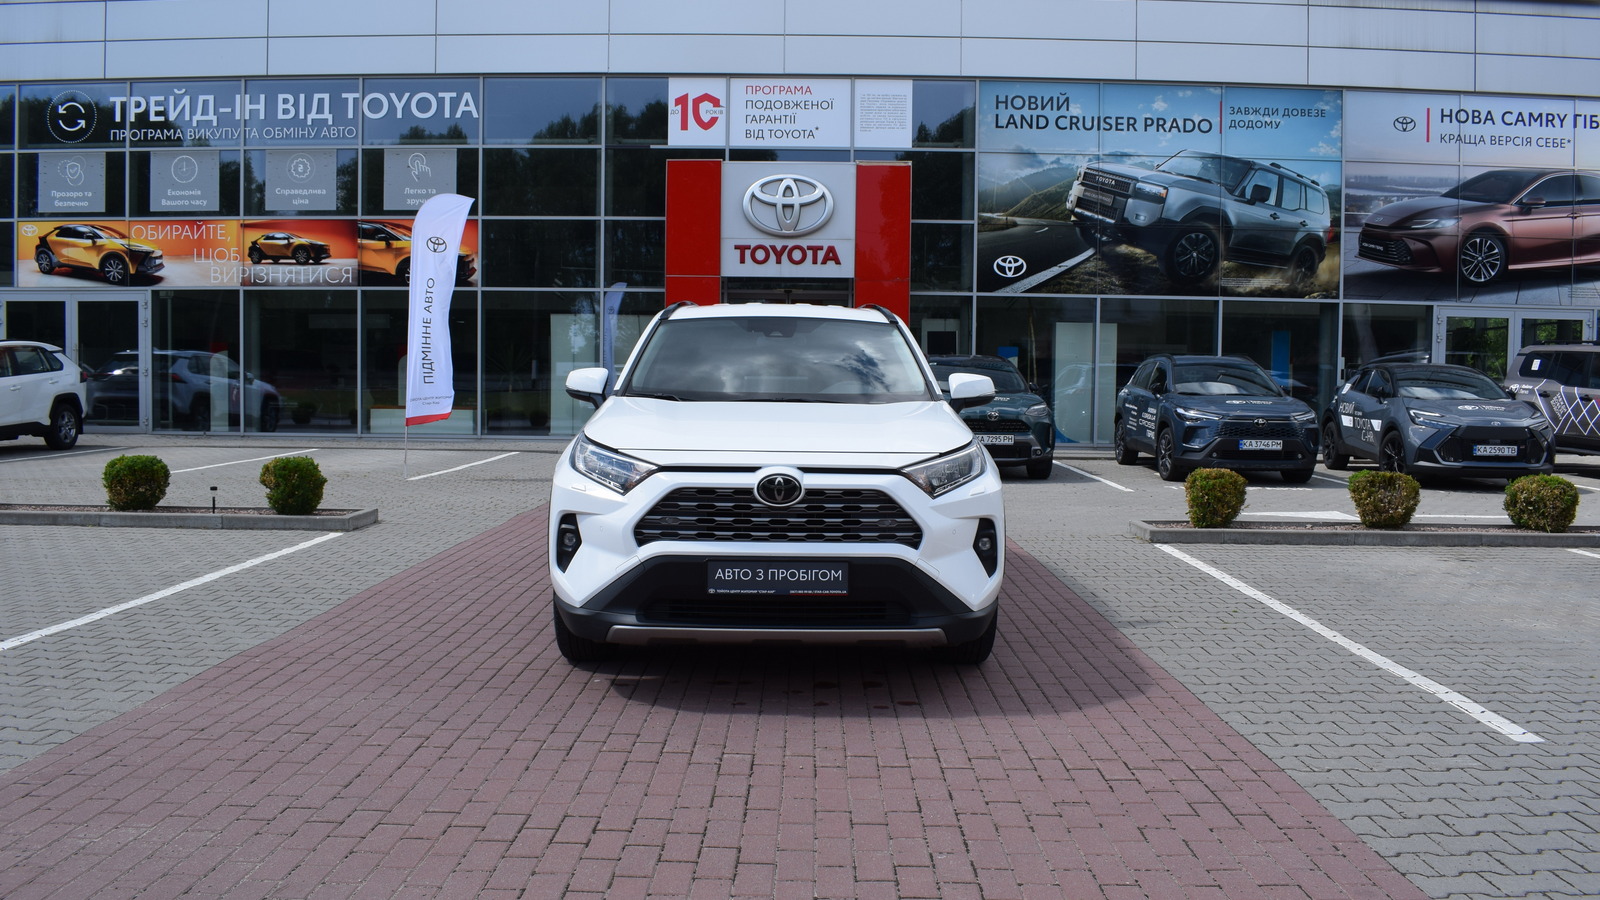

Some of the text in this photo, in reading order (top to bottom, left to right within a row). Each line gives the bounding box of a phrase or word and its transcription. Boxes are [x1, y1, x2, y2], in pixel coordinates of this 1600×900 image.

[745, 85, 812, 96] ПРОГРАМА
[110, 89, 479, 126] ТРЕЙД-ІН ВІД TOYOTA
[745, 98, 834, 112] ПОДОВЖЕНОЇ
[995, 92, 1070, 112] НОВИЙ
[745, 112, 796, 124] ГАРАНТІЇ
[1229, 106, 1326, 119] ЗАВЖДИ ДОВЕЗЕ
[1440, 108, 1496, 126] НОВА
[1501, 111, 1568, 130] CAMRY
[995, 114, 1212, 134] LAND CRUISER PRADO
[1229, 120, 1281, 130] ДОДОМУ
[110, 126, 356, 140] ПРОГРАМА ВИКУПУ ТА ОБМІНУ АВТО
[745, 129, 764, 141] ВІД
[1440, 134, 1486, 148] КРАЩА
[1490, 136, 1532, 148] ВЕРСІЯ
[1096, 176, 1116, 185] TOYOTA
[276, 188, 326, 196] Справедлива
[131, 222, 230, 242] ОБИРАЙТЕ,
[194, 248, 240, 263] ЩОБ
[734, 244, 842, 265] TOYOTA
[210, 266, 353, 283] ВИРІЗНЯТИСЯ
[424, 278, 435, 314] АВТО
[422, 317, 435, 384] ПІДМІННЕ
[1138, 418, 1156, 430] CROSS
[715, 568, 752, 580] АВТО
[768, 570, 842, 581] ПРОБІГОМ
